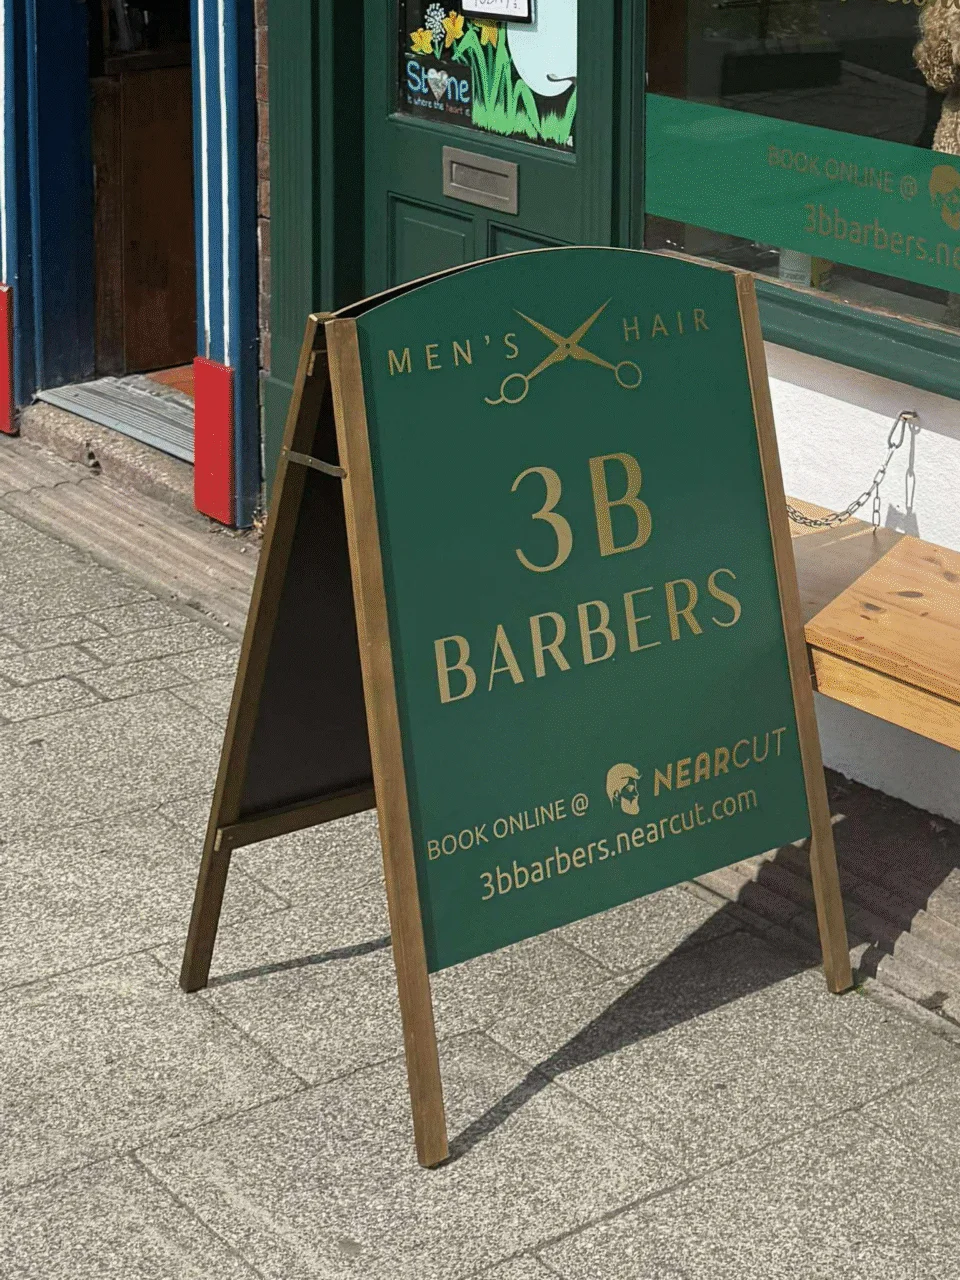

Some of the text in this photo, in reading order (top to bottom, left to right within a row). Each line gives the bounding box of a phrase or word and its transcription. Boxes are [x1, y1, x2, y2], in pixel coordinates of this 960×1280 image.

[766, 144, 821, 178] BOOK
[824, 157, 895, 197] ONLINE
[899, 174, 918, 201] @
[387, 307, 711, 376] MEN'S HAIR
[510, 451, 653, 574] 3B
[433, 567, 743, 704] BARBERS
[426, 726, 787, 861] BOOK ONLINE @ NEARCUT
[479, 788, 758, 901] 3bbarbers.nearcut.com
